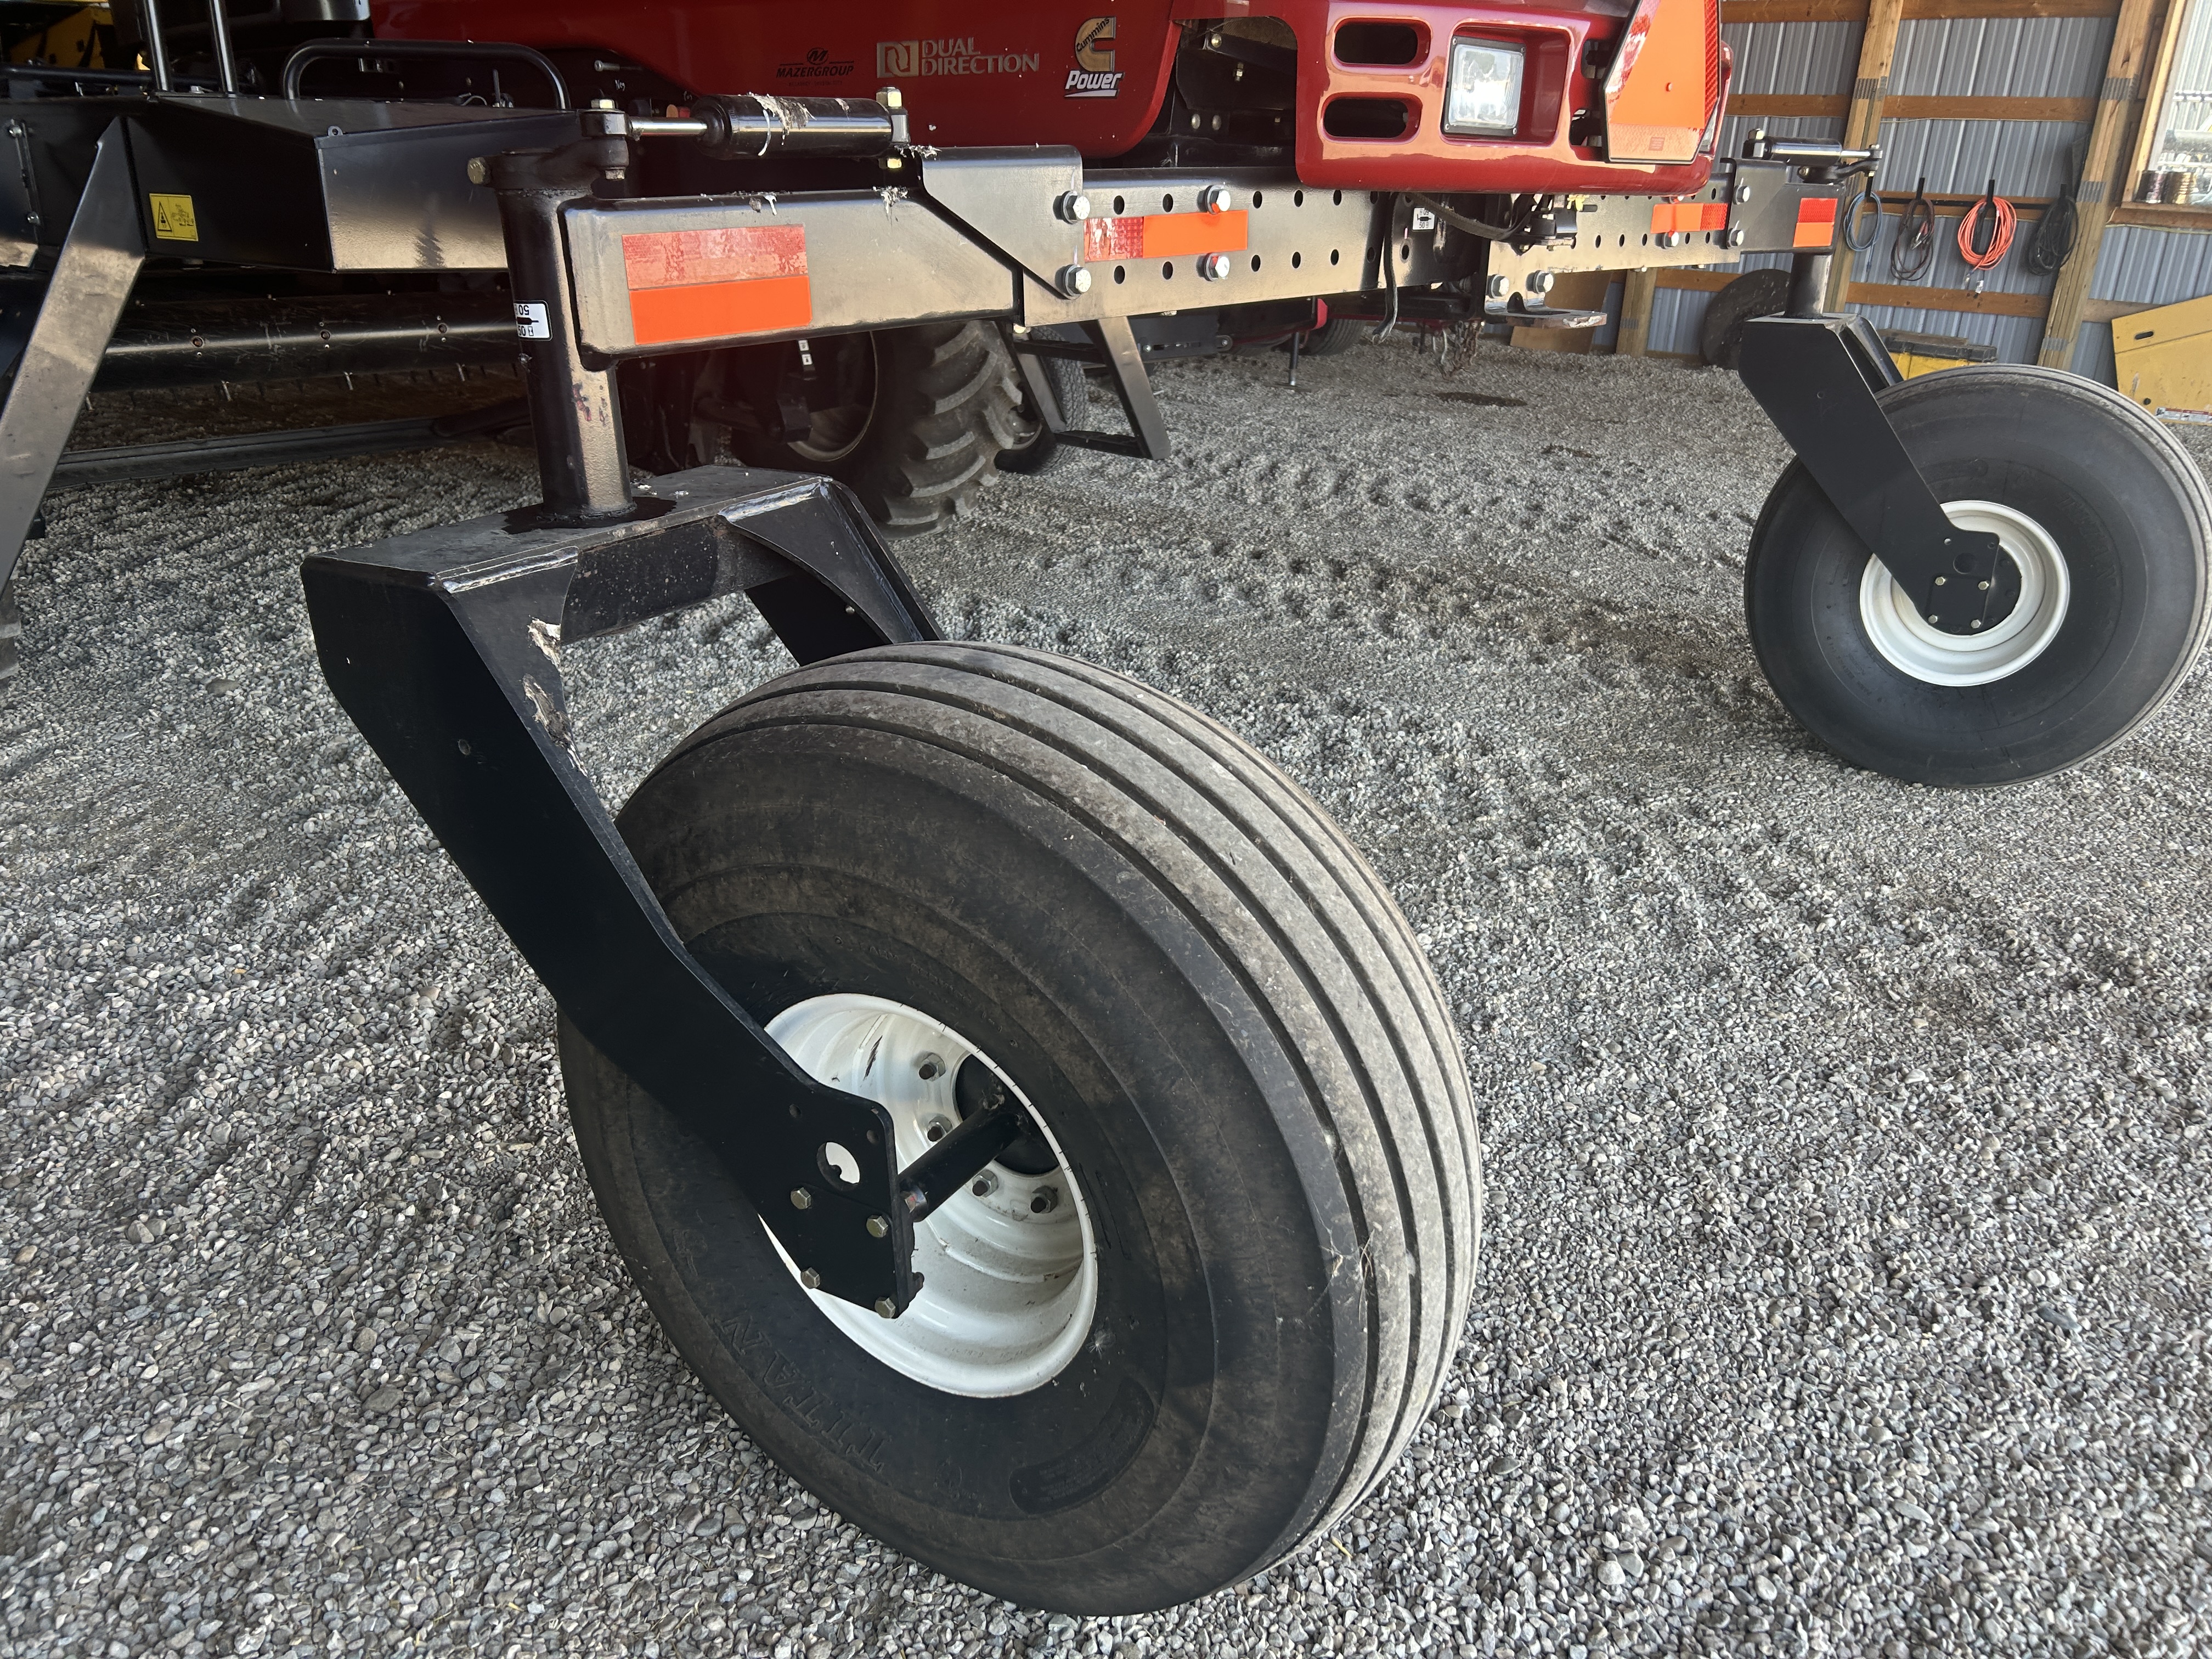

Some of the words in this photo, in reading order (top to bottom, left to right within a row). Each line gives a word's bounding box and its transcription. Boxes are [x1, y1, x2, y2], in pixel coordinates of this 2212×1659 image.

[1076, 17, 1110, 52] Cummins
[922, 37, 980, 58] DUAL
[776, 65, 854, 78] MAZERGROUP
[921, 53, 1040, 76] DIRECTION
[1065, 70, 1122, 89] Power
[518, 304, 529, 315] 50
[713, 1316, 893, 1472] TITAN
